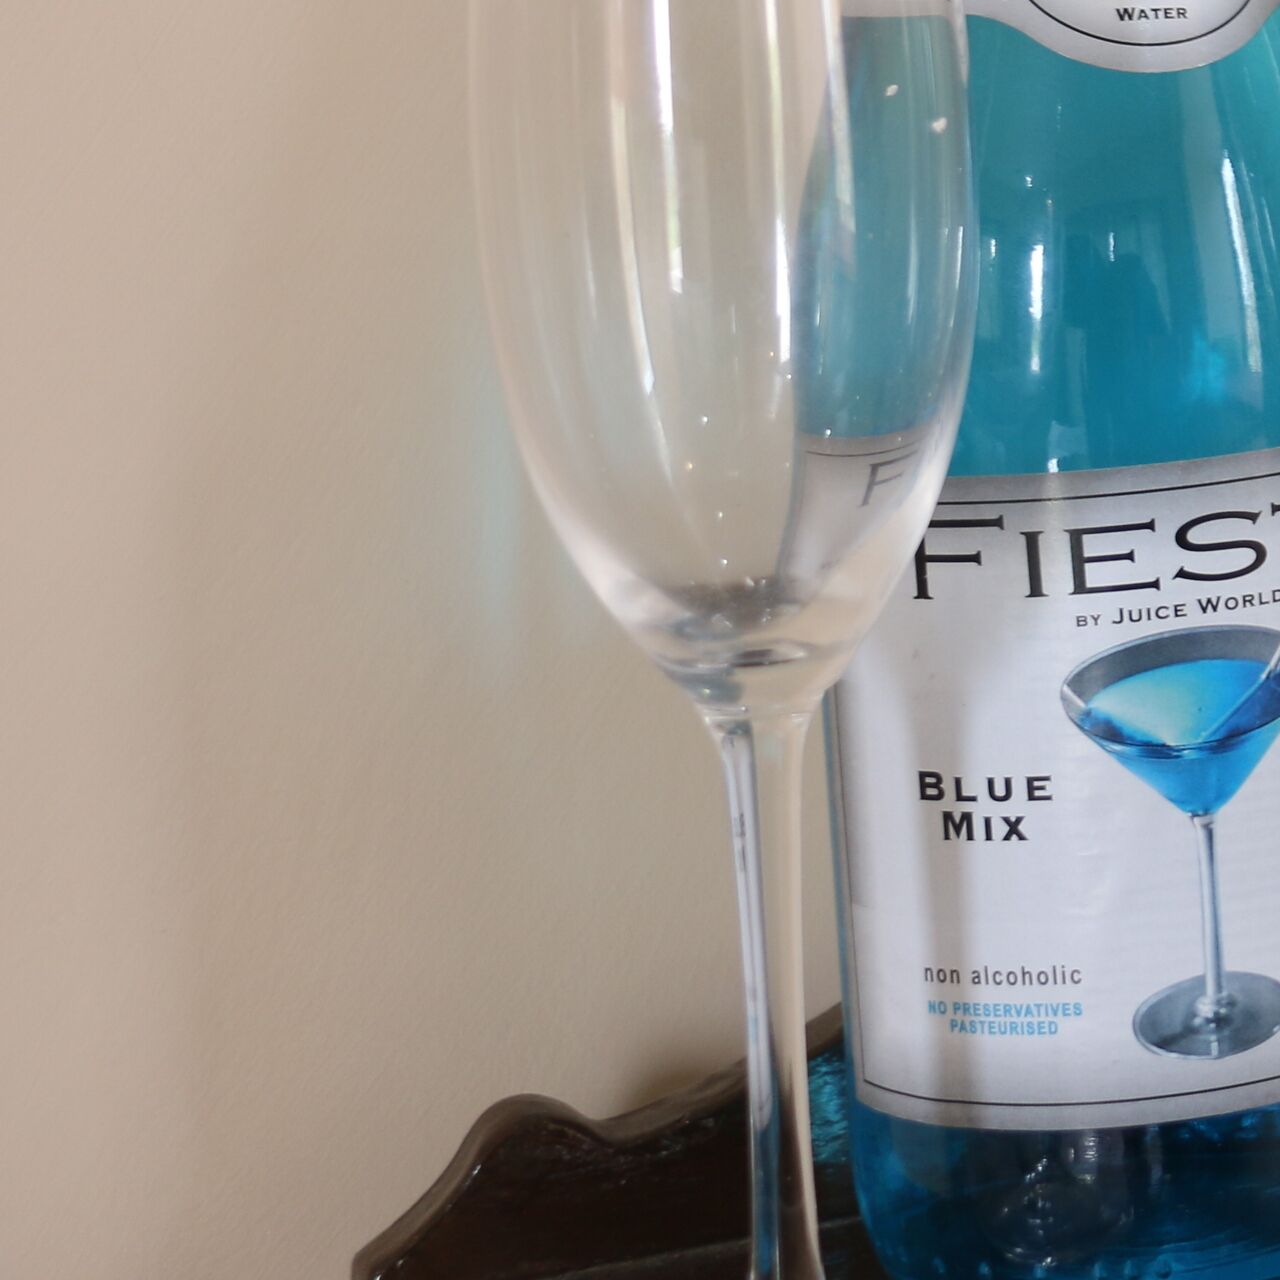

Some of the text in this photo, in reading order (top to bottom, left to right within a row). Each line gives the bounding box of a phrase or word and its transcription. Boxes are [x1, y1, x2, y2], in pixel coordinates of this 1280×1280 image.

[1115, 7, 1189, 22] WATER
[1076, 614, 1102, 628] BY
[1112, 603, 1188, 625] JUICE
[918, 770, 1054, 803] BLUE
[942, 810, 1029, 842] MIX
[924, 965, 1083, 987] non alcoholic
[927, 1000, 1084, 1018] NO PRESERVATIVES
[950, 1018, 1059, 1037] PASTEURISED
